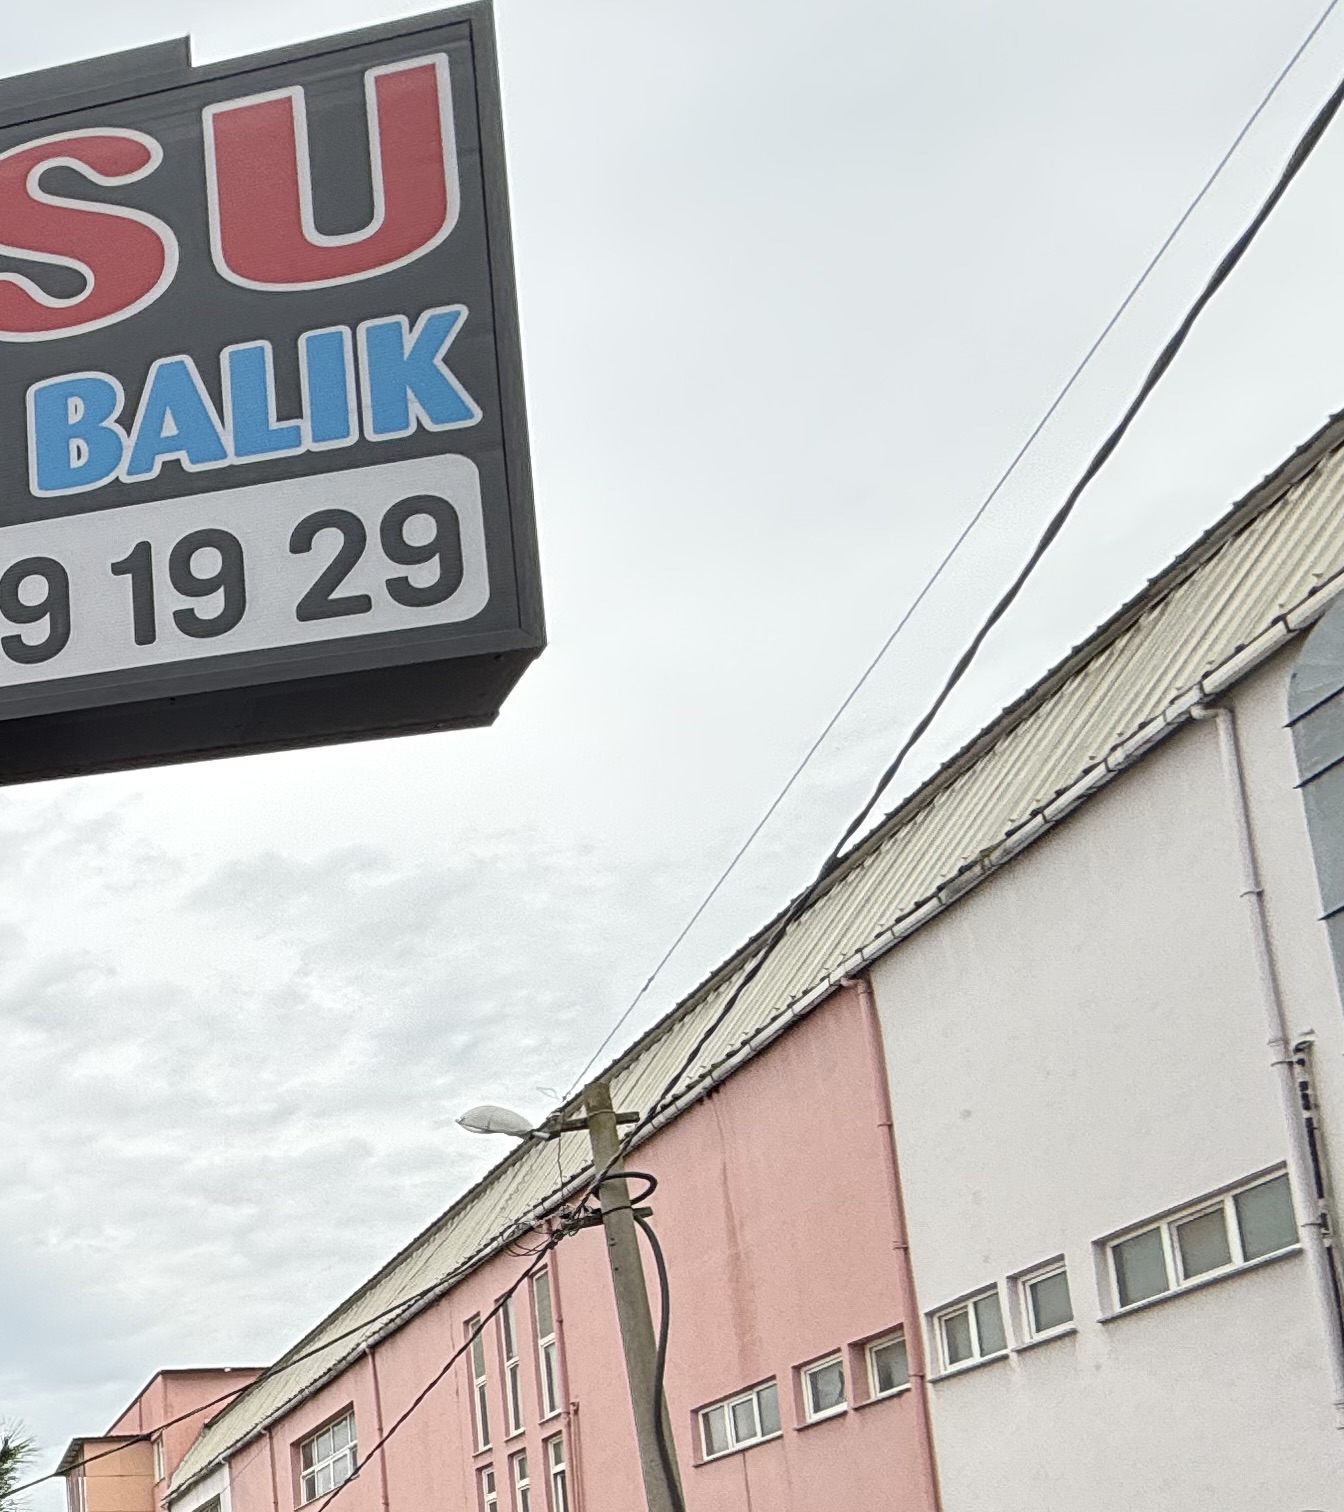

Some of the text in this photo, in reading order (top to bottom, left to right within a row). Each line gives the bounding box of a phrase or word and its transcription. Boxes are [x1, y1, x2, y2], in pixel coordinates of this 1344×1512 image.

[26, 305, 482, 500] BALIK
[111, 526, 247, 646] 19
[287, 493, 465, 623] 29
